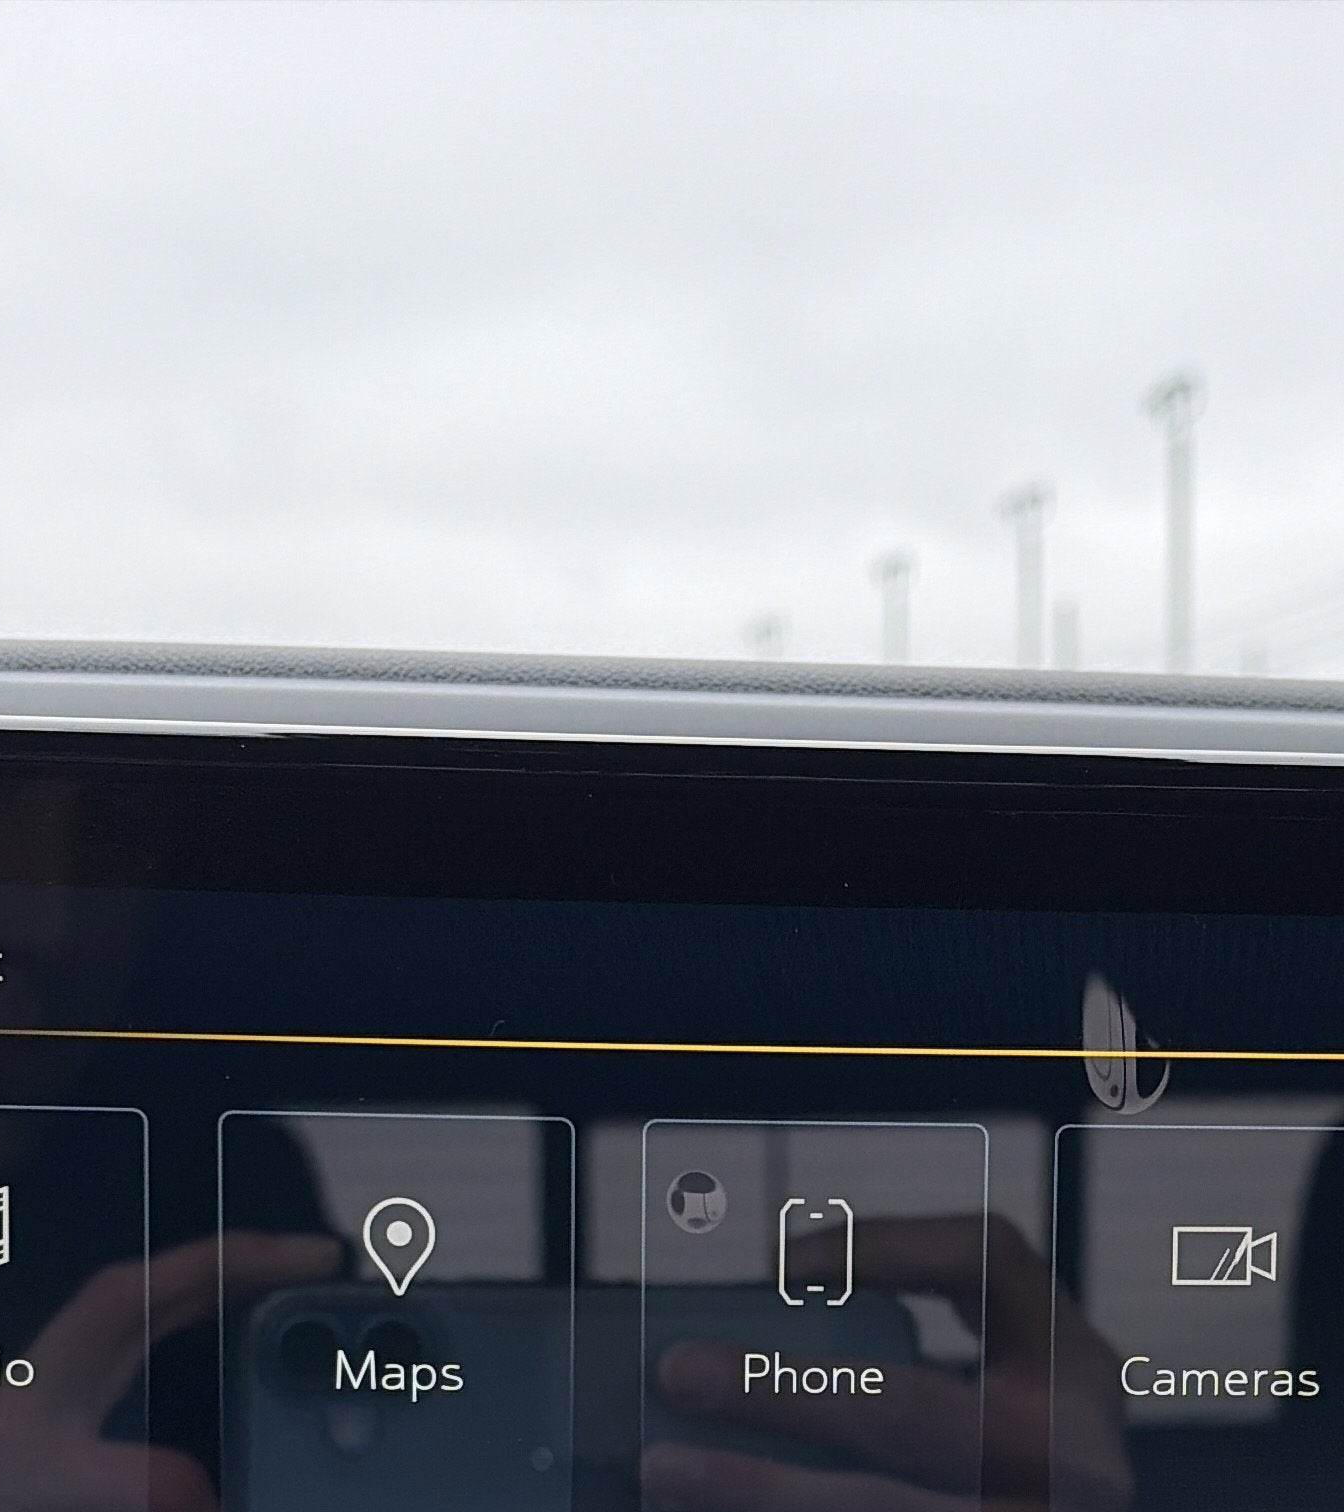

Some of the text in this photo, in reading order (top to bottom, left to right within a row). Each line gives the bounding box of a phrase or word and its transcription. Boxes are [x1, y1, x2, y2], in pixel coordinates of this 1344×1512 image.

[334, 1349, 465, 1403] Maps
[743, 1351, 885, 1395] Phone
[1120, 1355, 1321, 1398] Cameras
